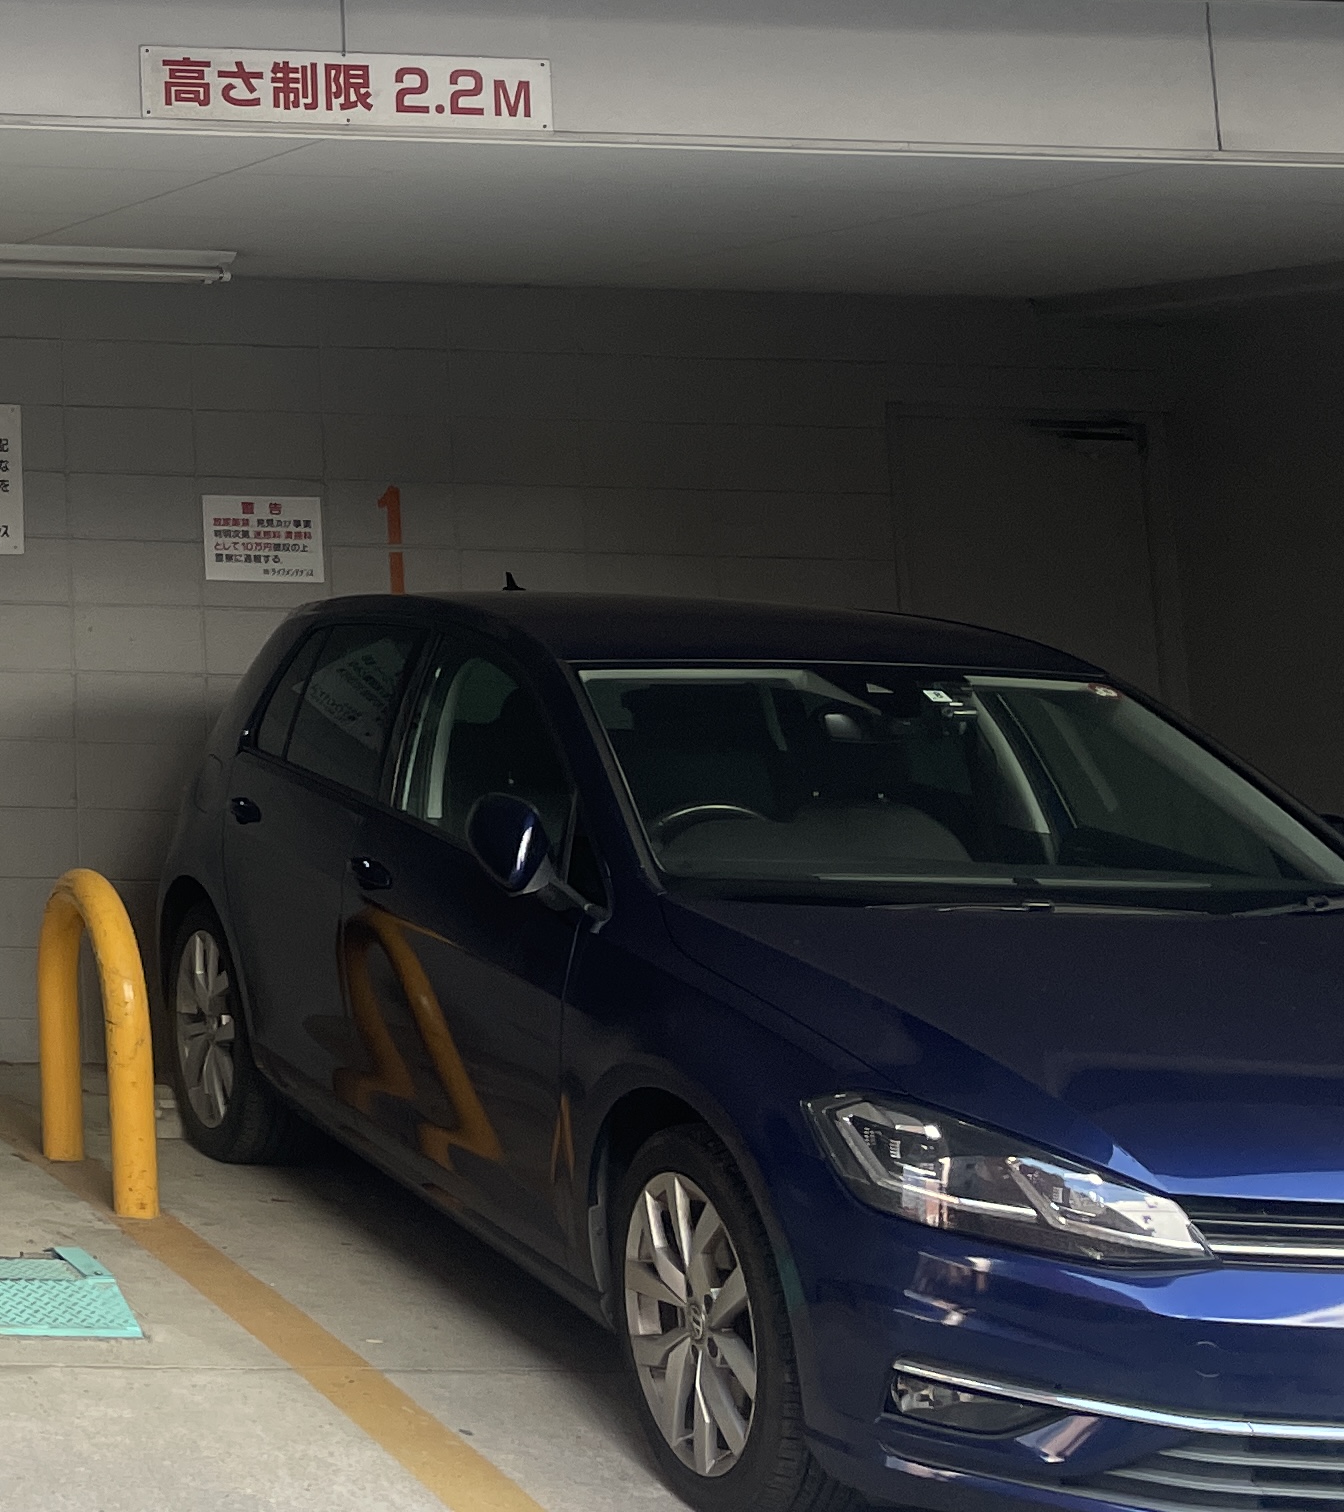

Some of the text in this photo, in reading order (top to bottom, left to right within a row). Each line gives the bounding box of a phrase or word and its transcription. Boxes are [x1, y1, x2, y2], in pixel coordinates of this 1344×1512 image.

[161, 56, 533, 119] 高さ制限 2.2M
[377, 484, 406, 596] 1
